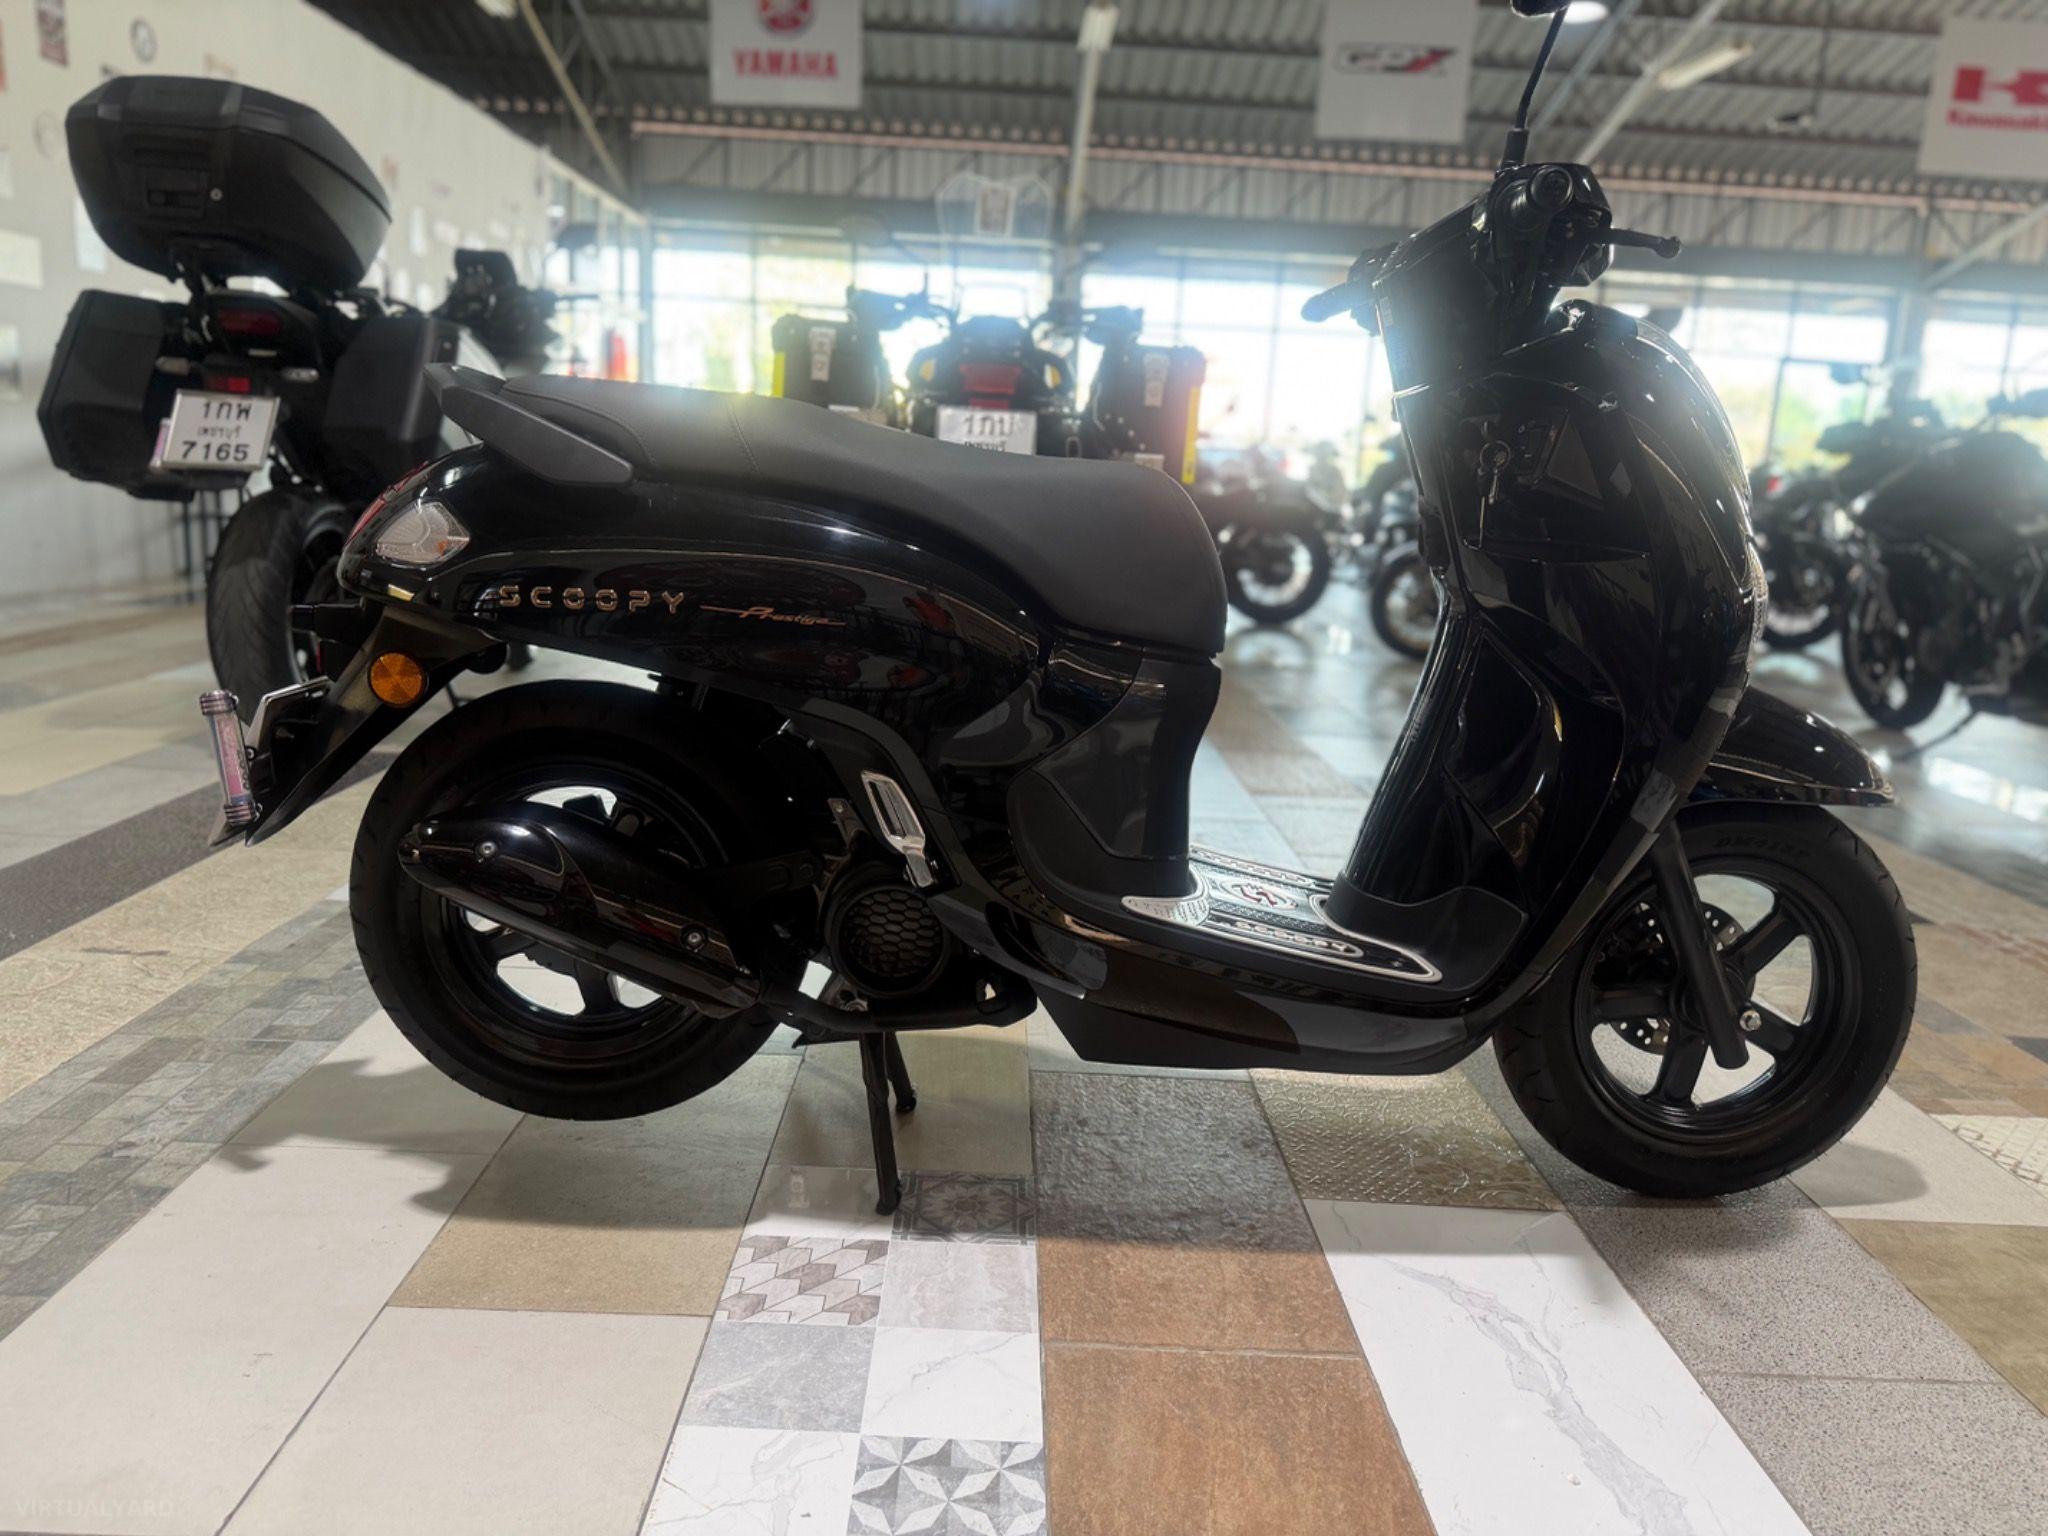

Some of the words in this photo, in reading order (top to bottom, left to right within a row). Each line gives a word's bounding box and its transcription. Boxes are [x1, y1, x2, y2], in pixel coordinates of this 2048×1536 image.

[732, 49, 838, 78] YAMAHA
[181, 441, 250, 461] 7165
[499, 585, 685, 614] SCOOPY
